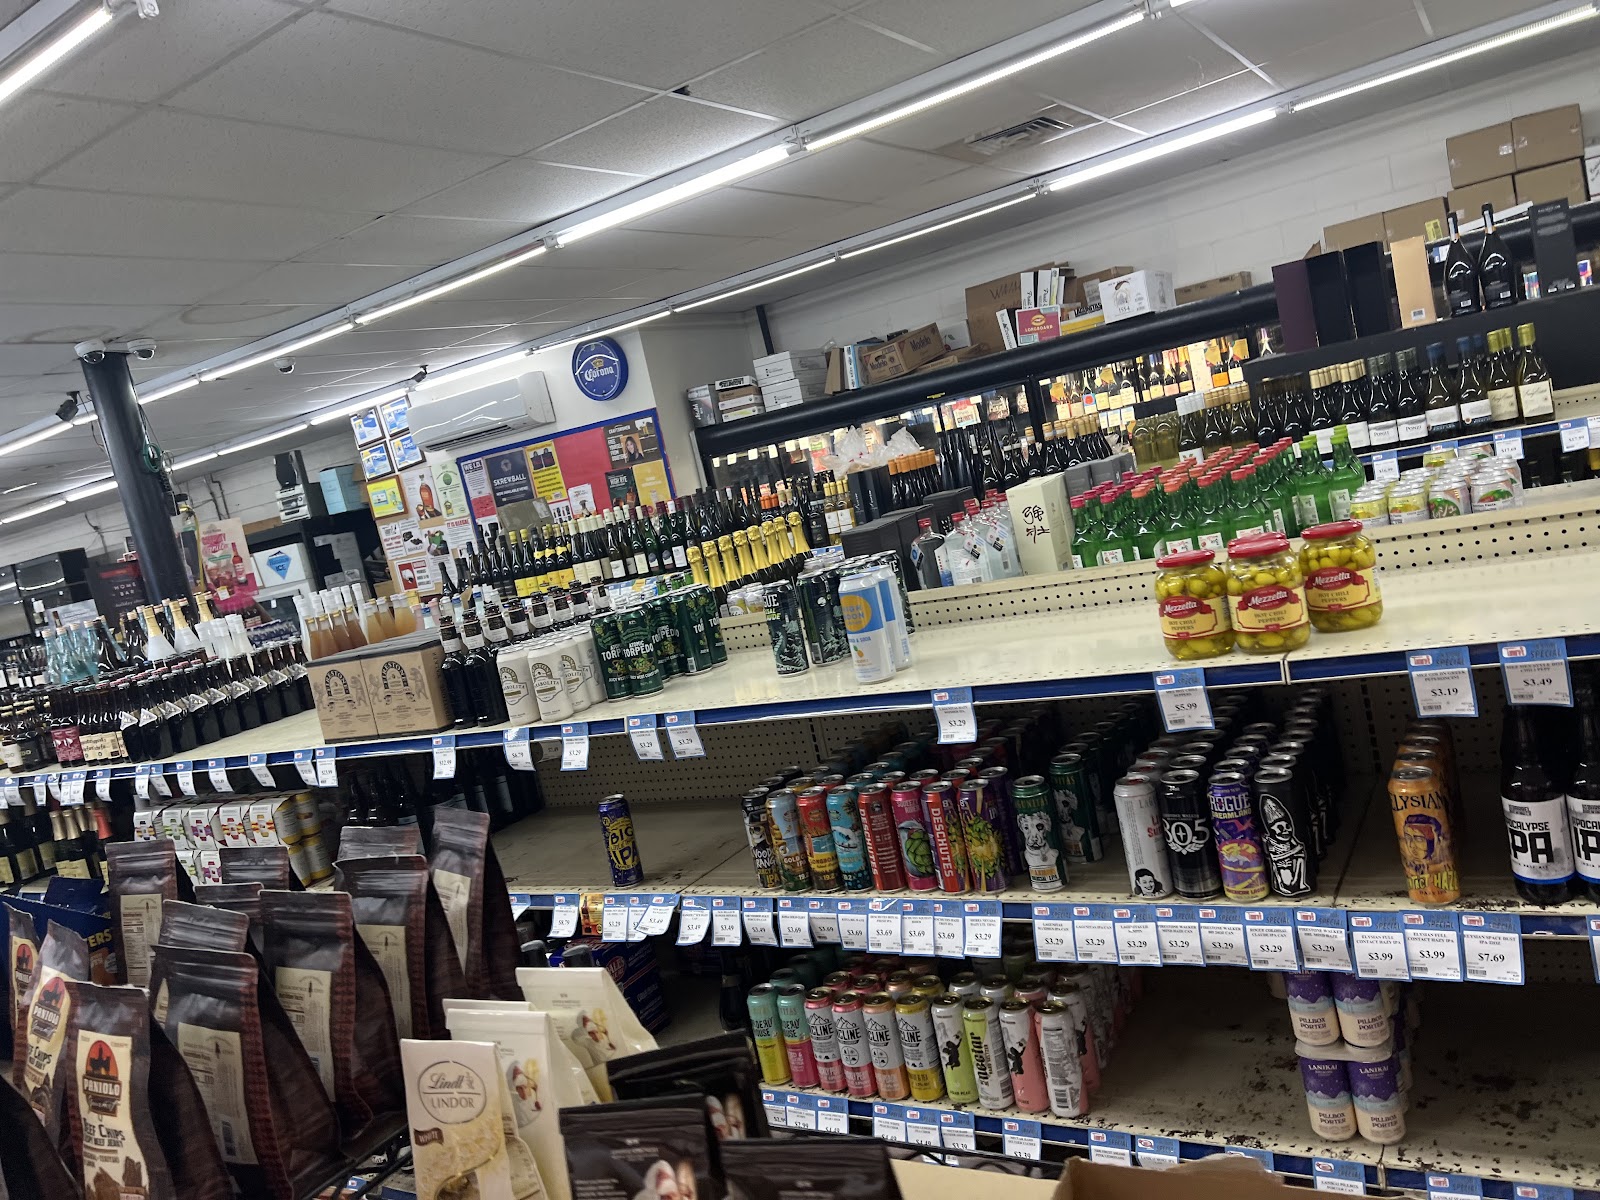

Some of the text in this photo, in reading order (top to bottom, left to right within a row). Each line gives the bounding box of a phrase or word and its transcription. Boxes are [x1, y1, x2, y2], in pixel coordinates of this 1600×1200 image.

[910, 336, 931, 352] Modelo
[870, 359, 888, 370] Modelo
[584, 365, 614, 382] Corona
[463, 463, 472, 472] WE
[493, 474, 527, 486] SKREWBALL
[275, 563, 286, 572] ICE
[1313, 572, 1351, 586] Mezzetta
[114, 582, 137, 590] HOME
[119, 589, 135, 597] BAR
[1247, 591, 1288, 606] Mezzetta
[1163, 601, 1198, 614] Mezzetta
[623, 643, 654, 658] TORPEDO
[1523, 678, 1553, 687] $3.49
[1431, 687, 1459, 697] $3.19
[1175, 702, 1198, 712] $5.99
[948, 719, 967, 728] $3.29
[1210, 794, 1251, 812] ROGUE
[610, 826, 634, 846] BIG
[859, 808, 879, 876] DESCHUTES
[931, 808, 954, 878] DESCHUTES
[1510, 828, 1555, 864] PA
[1574, 826, 1600, 861] IP
[612, 841, 638, 865] IPA
[784, 855, 799, 863] GOLD
[88, 929, 112, 947] ERS
[876, 929, 893, 937] $3.69
[908, 930, 925, 938] $3.69
[937, 932, 955, 940] $3.69
[1044, 938, 1064, 946] $3.29
[1085, 938, 1105, 947] $3.29
[1127, 941, 1148, 949] $3.29
[1168, 940, 1190, 949] $3.29
[1211, 942, 1234, 950] $3.29
[1259, 945, 1283, 953] $3.29
[1311, 944, 1335, 952] $3.29
[1368, 952, 1393, 961] $3.99
[1419, 950, 1445, 959] $3.99
[1478, 953, 1505, 962] $7.69
[33, 1005, 60, 1027] PANIOLO
[1357, 1015, 1383, 1025] PILLBOX
[1358, 1021, 1384, 1031] PORTER
[1359, 1065, 1389, 1074] LANIKAI
[428, 1073, 464, 1090] Lindt
[83, 1078, 120, 1097] PANIOLO
[430, 1097, 476, 1109] LINDOR
[1370, 1114, 1397, 1122] PILLBOX
[1372, 1120, 1398, 1128] PORTER
[99, 1125, 126, 1141] CHIPS
[418, 1130, 439, 1143] WHITE
